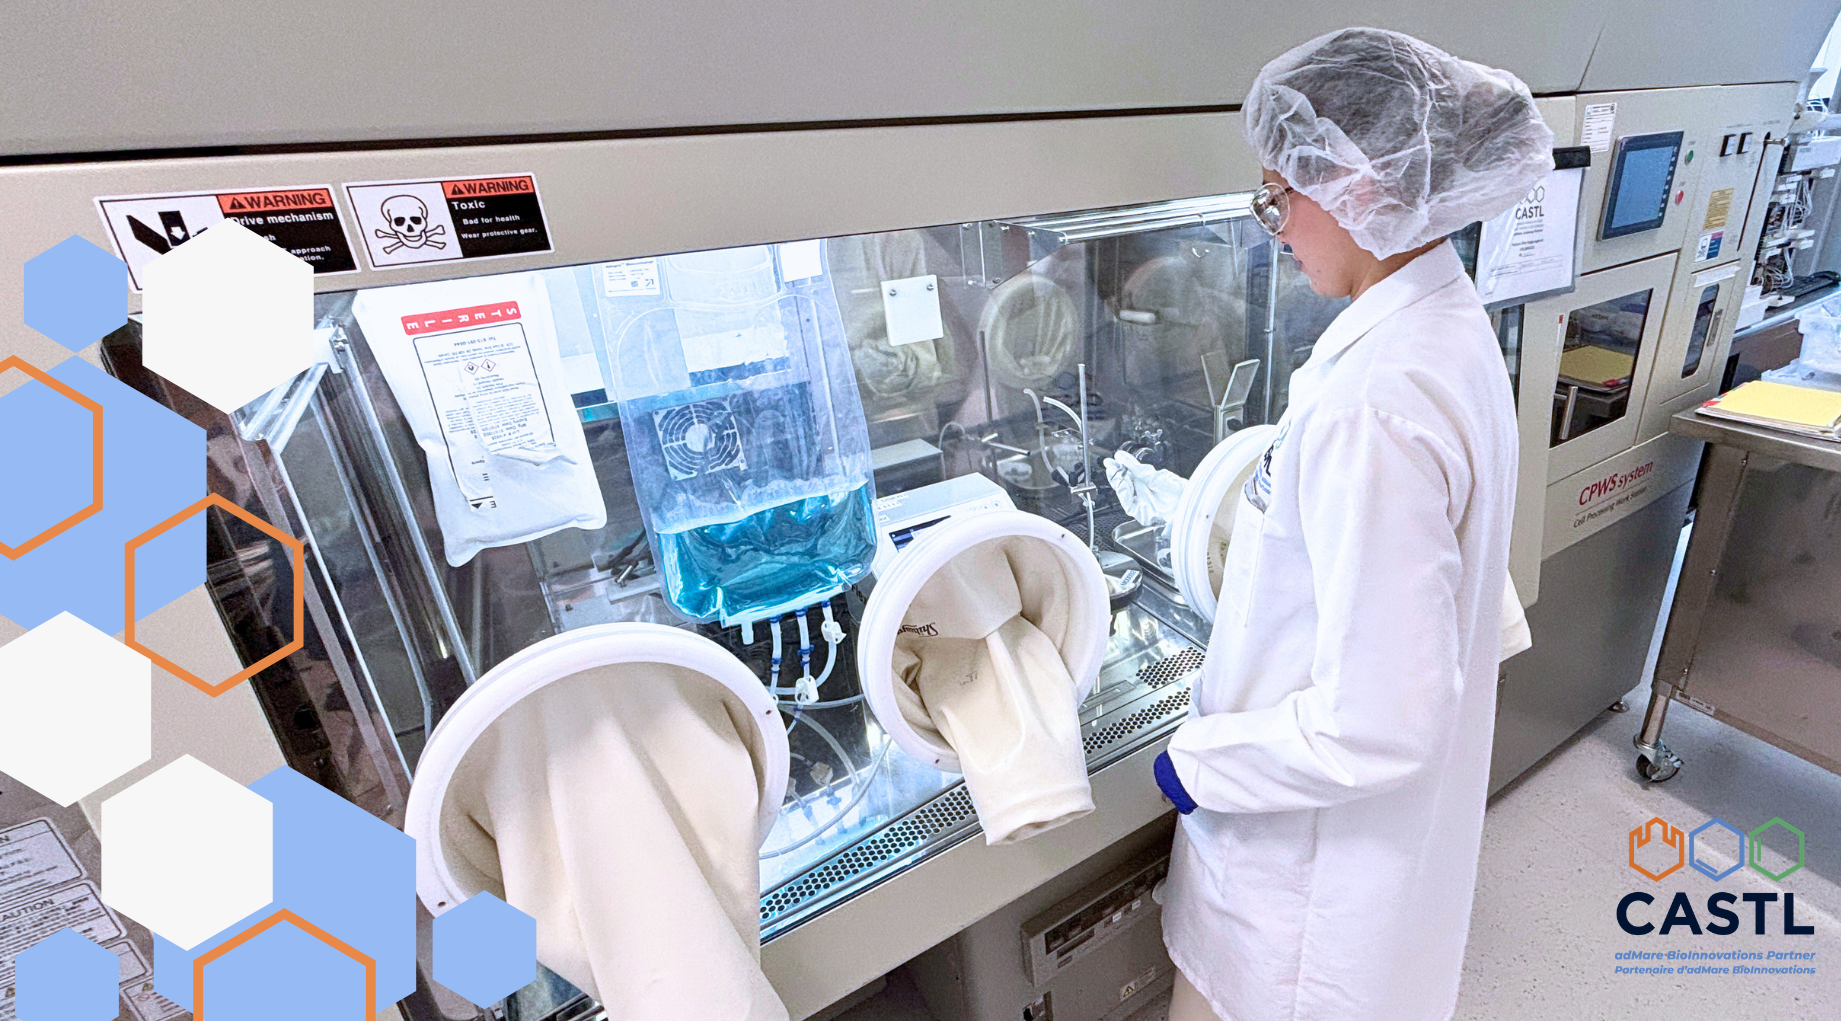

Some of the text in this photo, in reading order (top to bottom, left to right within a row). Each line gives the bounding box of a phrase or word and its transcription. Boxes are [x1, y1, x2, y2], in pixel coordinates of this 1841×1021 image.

[463, 180, 529, 194] WARNING
[245, 192, 327, 209] WARNING
[451, 200, 485, 210] Toxic
[267, 211, 334, 224] mechanism
[1515, 205, 1544, 220] CASTL
[482, 229, 518, 238] protective
[291, 245, 332, 255] approach
[406, 307, 518, 330] STERILE
[1579, 461, 1654, 506] CPWS system
[2, 898, 54, 920] AUTION
